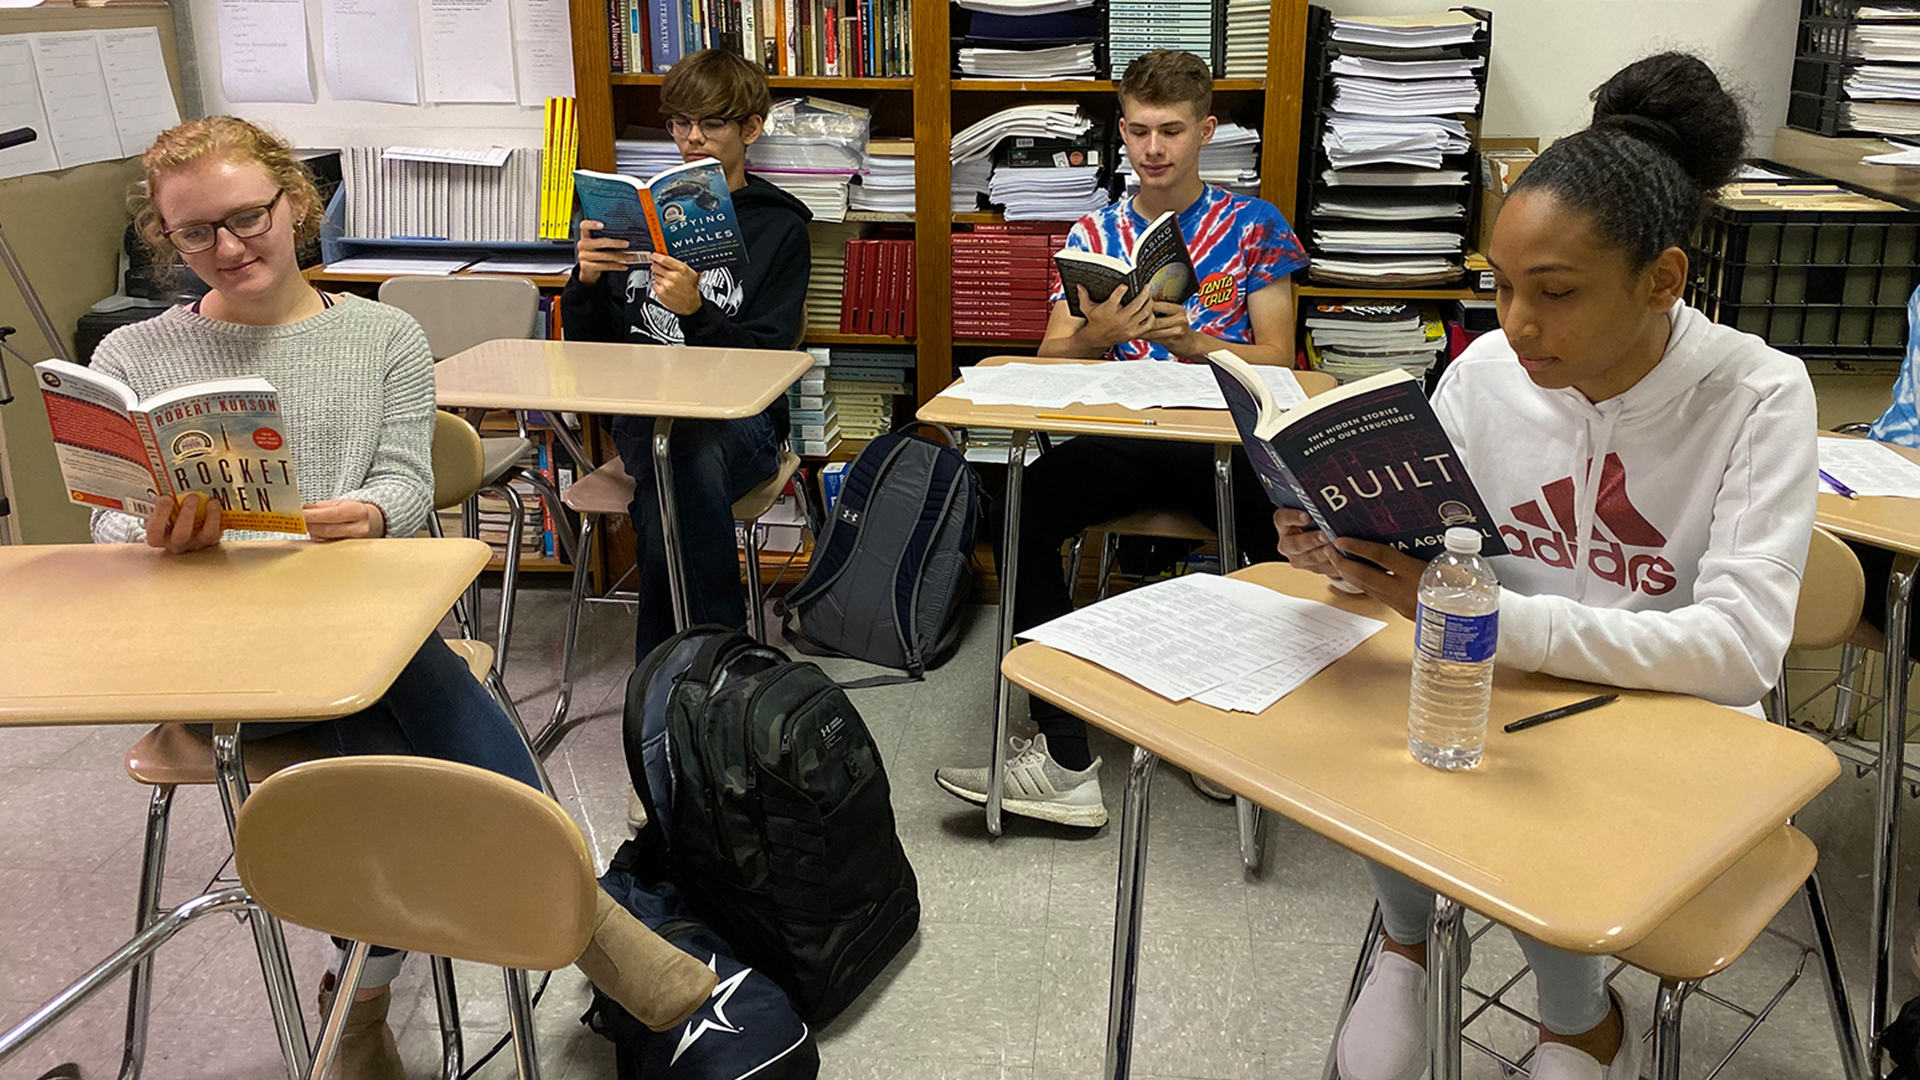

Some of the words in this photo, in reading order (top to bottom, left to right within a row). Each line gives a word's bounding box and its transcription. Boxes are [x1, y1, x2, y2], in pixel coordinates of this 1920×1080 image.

[670, 213, 726, 233] SPYING
[672, 230, 733, 248] WHALES
[1198, 275, 1234, 296] SANTA
[1204, 289, 1232, 308] CRUZ
[155, 402, 211, 427] ROBERT
[219, 399, 276, 412] KURSON
[1307, 432, 1324, 443] THE
[1325, 418, 1360, 435] HIDDEN
[1362, 407, 1399, 422] STORIES
[1303, 437, 1336, 456] BEHIND
[1338, 429, 1358, 440] OUR
[1359, 414, 1416, 432] STRUCTURES
[174, 458, 290, 491] ROCKET
[1320, 454, 1452, 512] BUILT
[212, 487, 272, 512] MEN
[1414, 528, 1492, 548] AGRL
